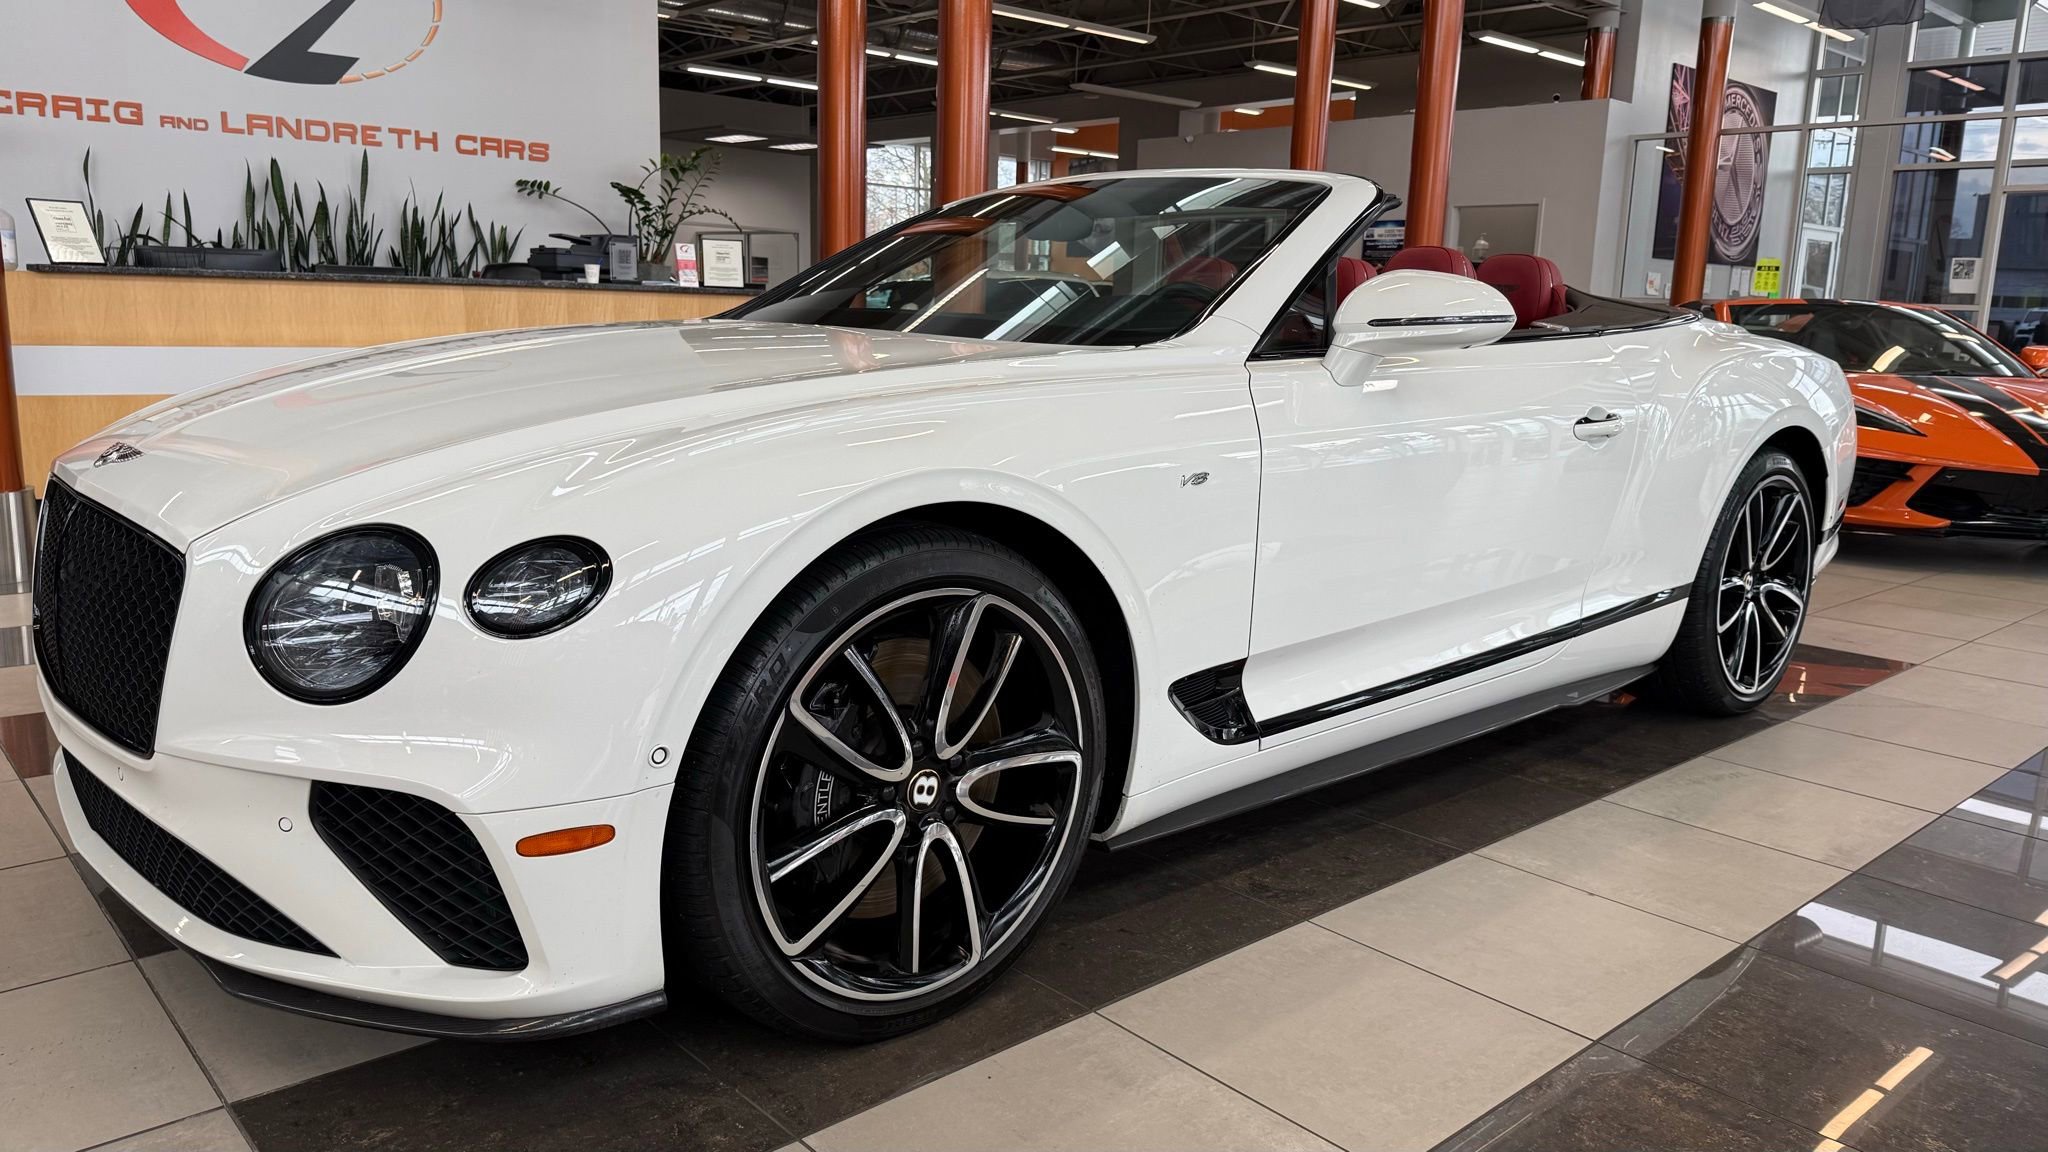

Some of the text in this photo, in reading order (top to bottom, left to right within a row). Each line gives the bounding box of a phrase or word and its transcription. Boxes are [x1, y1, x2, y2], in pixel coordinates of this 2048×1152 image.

[159, 115, 209, 132] AND
[220, 111, 439, 152] LANDRETH
[455, 134, 550, 163] CARS
[1725, 94, 1761, 152] MERCEDS
[1180, 472, 1210, 488] V8
[817, 771, 832, 824] ENTLE
[913, 776, 938, 805] B
